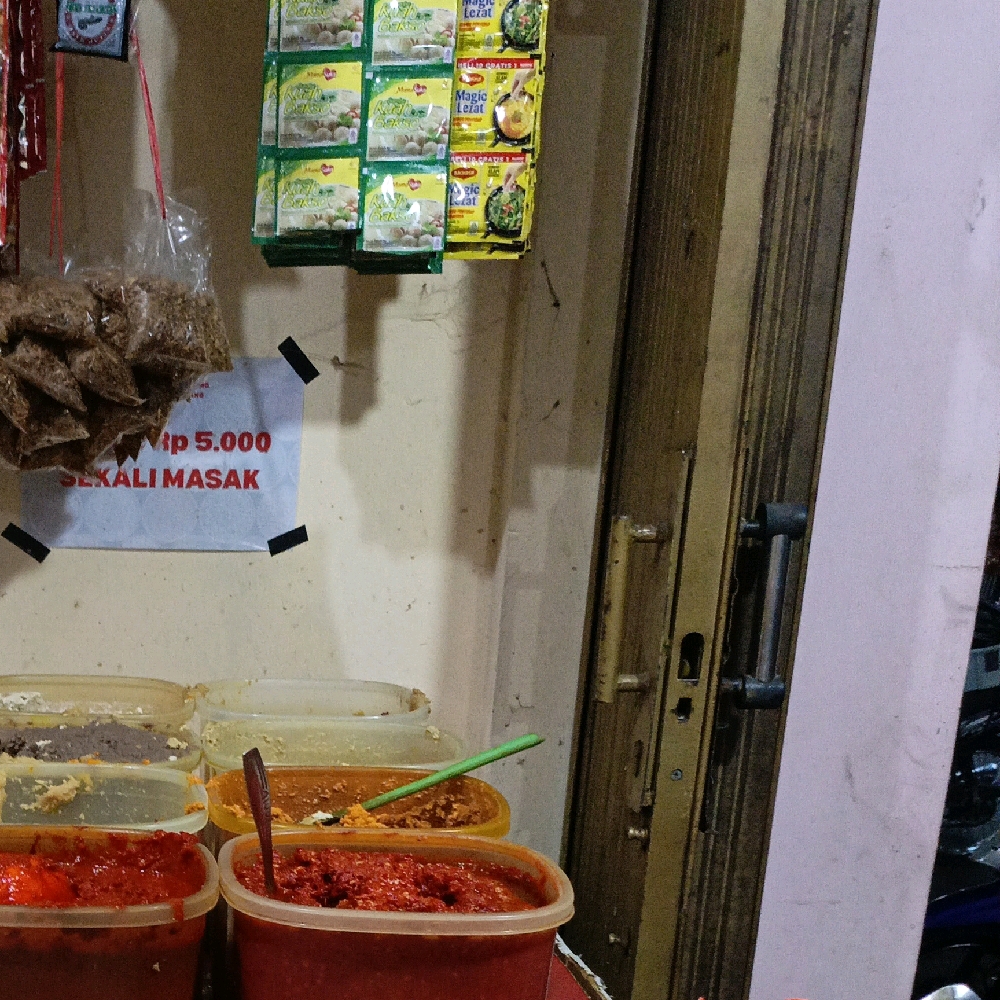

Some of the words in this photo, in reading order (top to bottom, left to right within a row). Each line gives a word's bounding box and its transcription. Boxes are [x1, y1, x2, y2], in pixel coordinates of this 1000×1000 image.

[455, 89, 488, 105] Magic
[457, 104, 485, 114] Lezat
[194, 431, 272, 454] 5.000
[162, 469, 260, 490] MASAK
